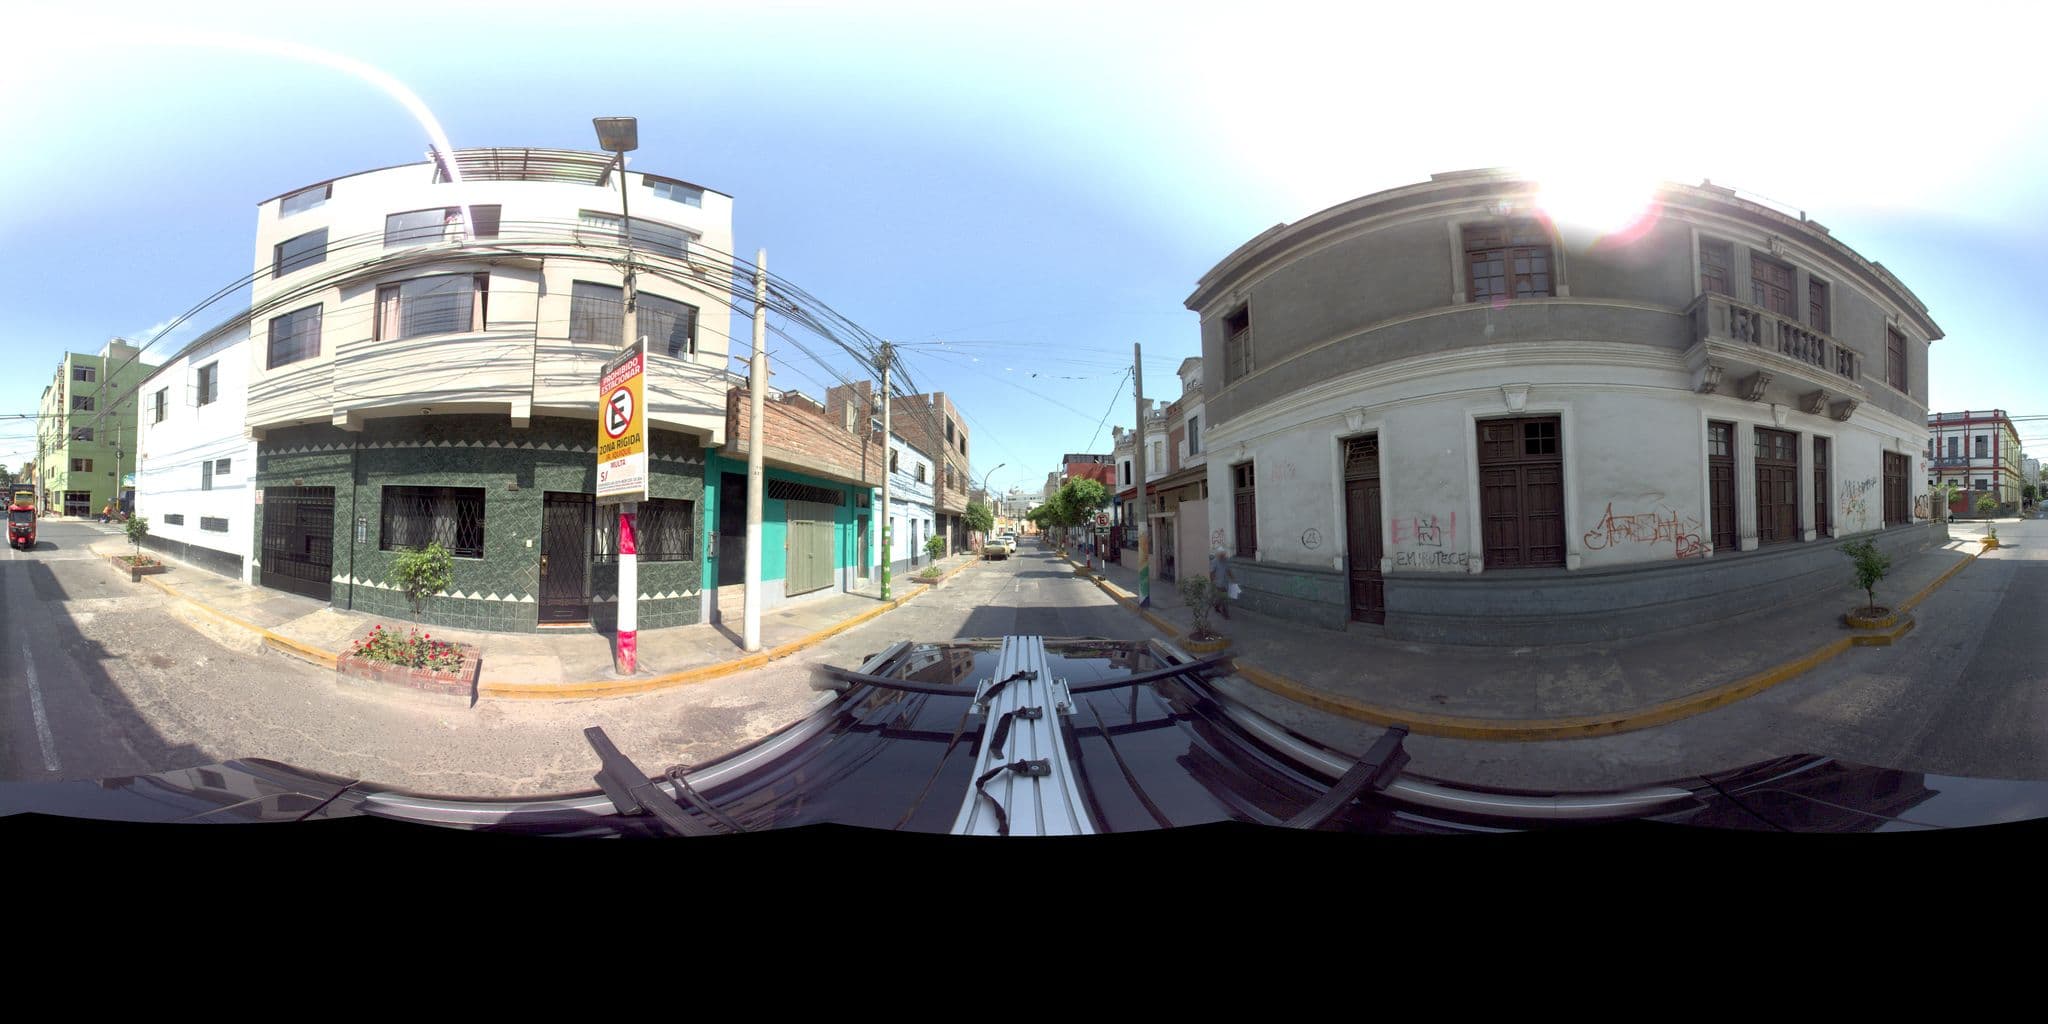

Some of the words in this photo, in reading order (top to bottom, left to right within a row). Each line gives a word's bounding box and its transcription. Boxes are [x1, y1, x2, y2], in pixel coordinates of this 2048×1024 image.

[601, 365, 641, 395] ESTACIONAR
[603, 357, 638, 385] PROHIBIDO
[611, 393, 626, 431] E
[599, 442, 615, 455] ZONA
